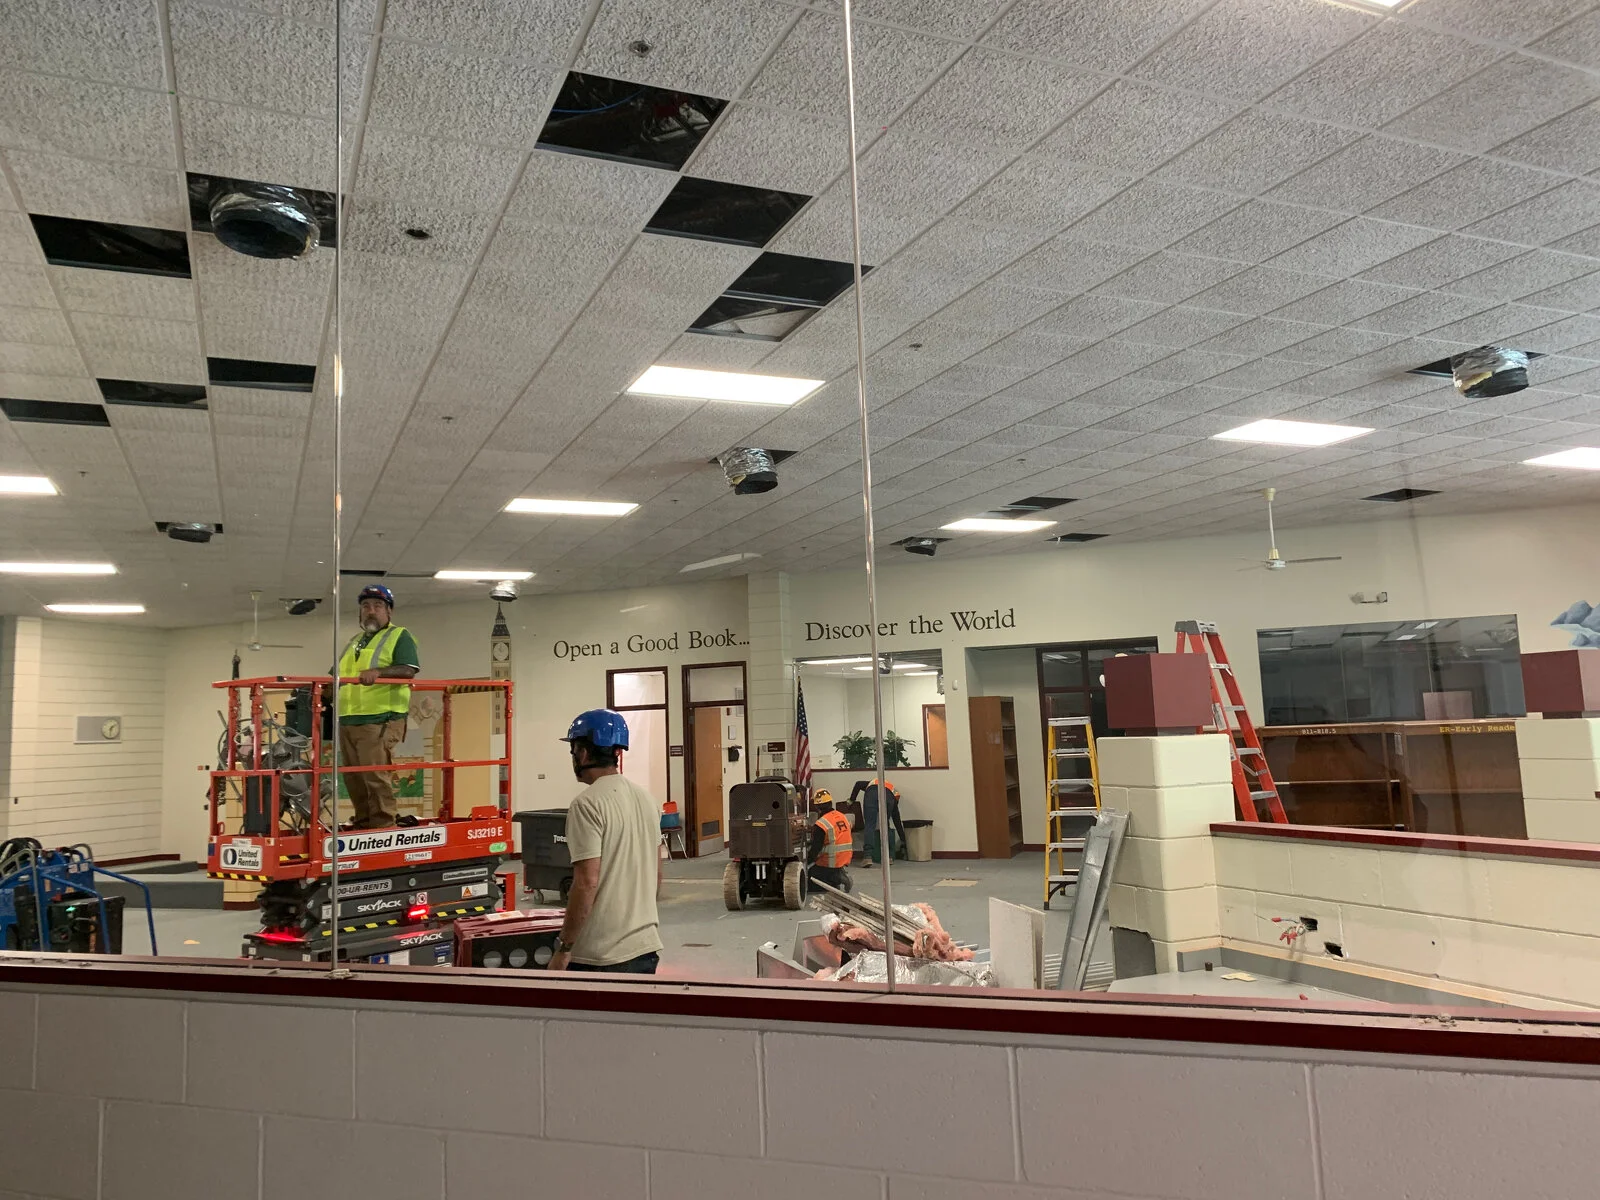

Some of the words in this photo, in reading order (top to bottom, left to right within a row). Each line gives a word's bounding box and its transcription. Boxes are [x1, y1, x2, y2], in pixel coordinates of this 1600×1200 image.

[805, 621, 898, 641] Discover
[909, 615, 944, 634] the
[950, 608, 1016, 631] World
[553, 640, 602, 661] Open
[610, 641, 619, 655] a
[627, 632, 679, 653] Good
[1487, 724, 1516, 733] Reade
[467, 827, 496, 840] SJ3219
[497, 826, 503, 836] E
[553, 834, 567, 844] Tote
[348, 835, 393, 852] United
[395, 830, 441, 846] Rentals
[238, 849, 258, 858] United
[238, 857, 260, 867] Rentals
[357, 899, 402, 912] SKYJACK
[400, 931, 443, 947] SKYJACK
